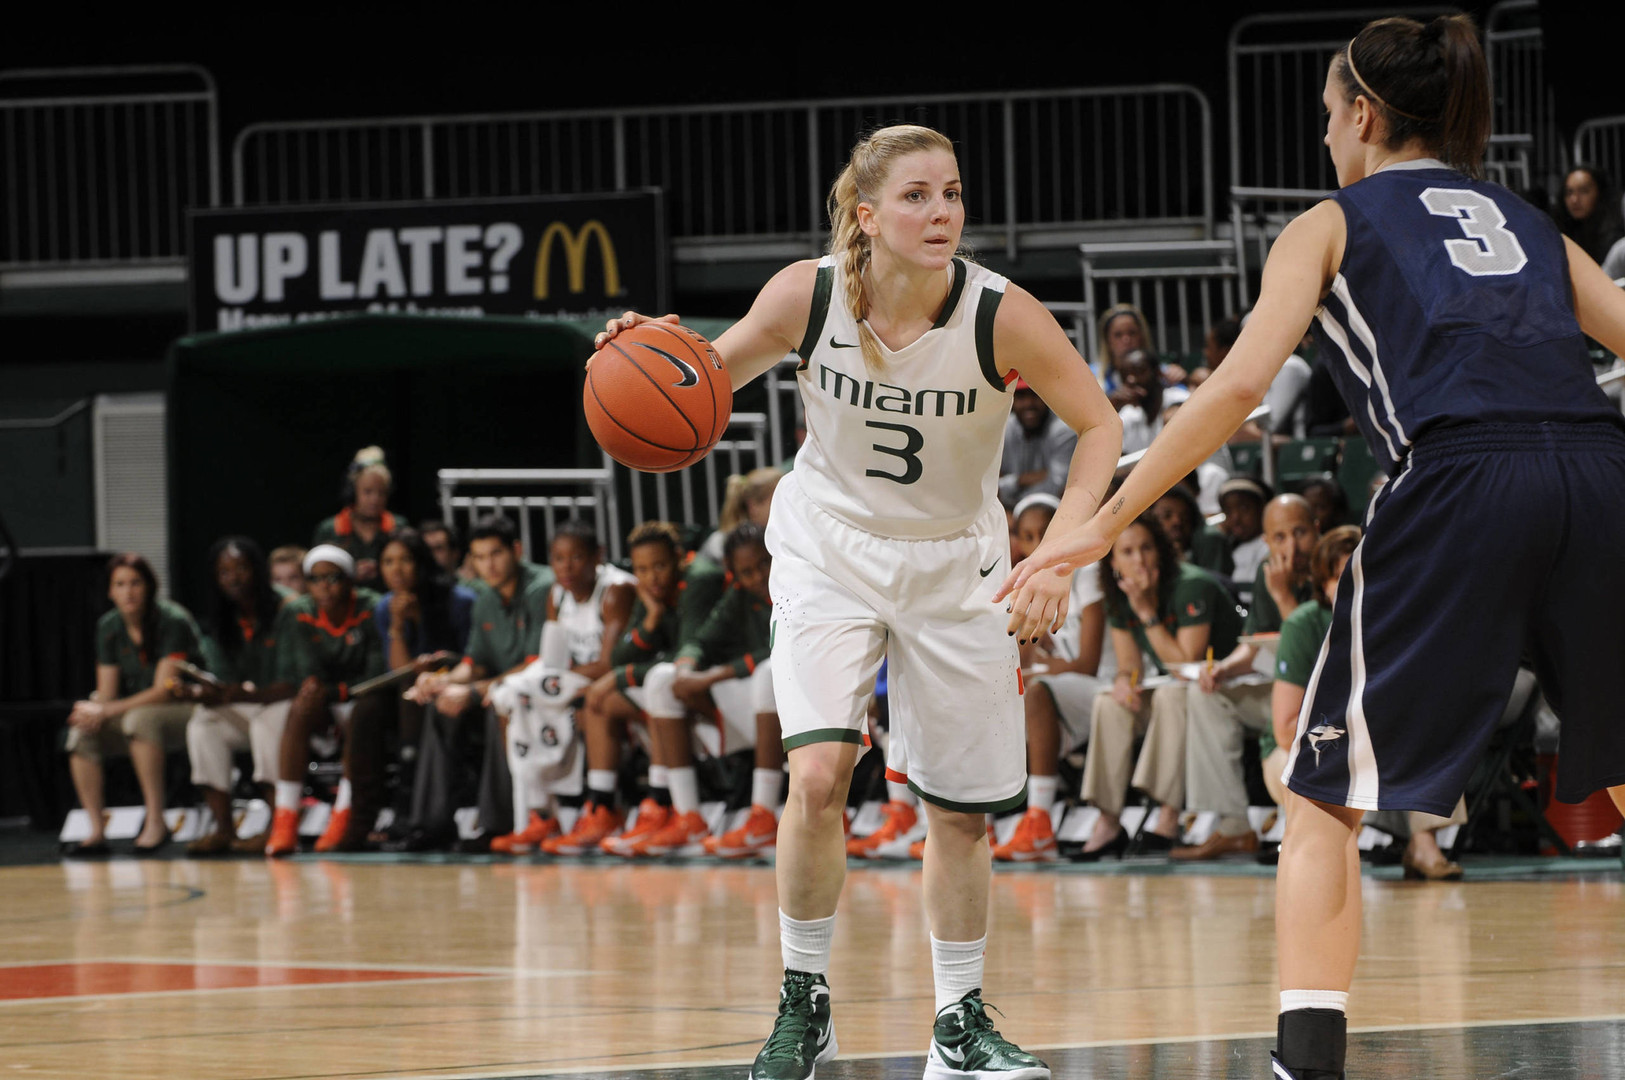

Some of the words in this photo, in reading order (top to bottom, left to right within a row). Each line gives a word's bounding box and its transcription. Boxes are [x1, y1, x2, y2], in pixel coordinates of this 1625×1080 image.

[213, 231, 308, 305] UP
[318, 222, 523, 300] LATE?
[1418, 187, 1528, 276] 3
[865, 420, 924, 485] 3
